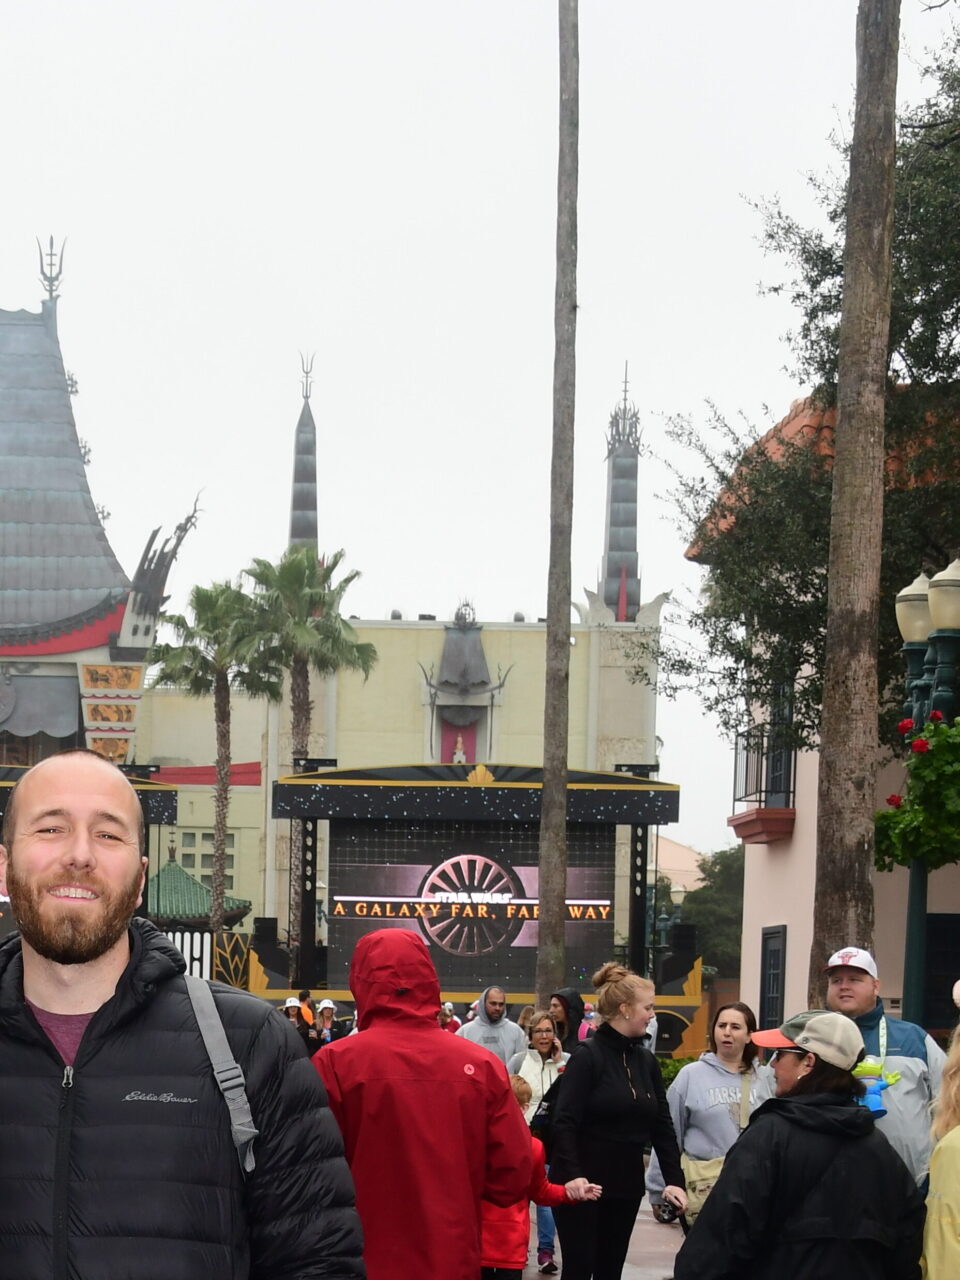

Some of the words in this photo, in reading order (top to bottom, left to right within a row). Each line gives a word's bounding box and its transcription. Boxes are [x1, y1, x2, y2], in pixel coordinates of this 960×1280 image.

[435, 892, 471, 903] STAR
[470, 892, 513, 904] WARS
[333, 902, 345, 915] A
[355, 902, 441, 917] GALAXY
[451, 904, 496, 919] FAR,
[568, 906, 610, 919] WAY
[121, 1091, 158, 1101] Eddie
[158, 1092, 198, 1103] Bauer
